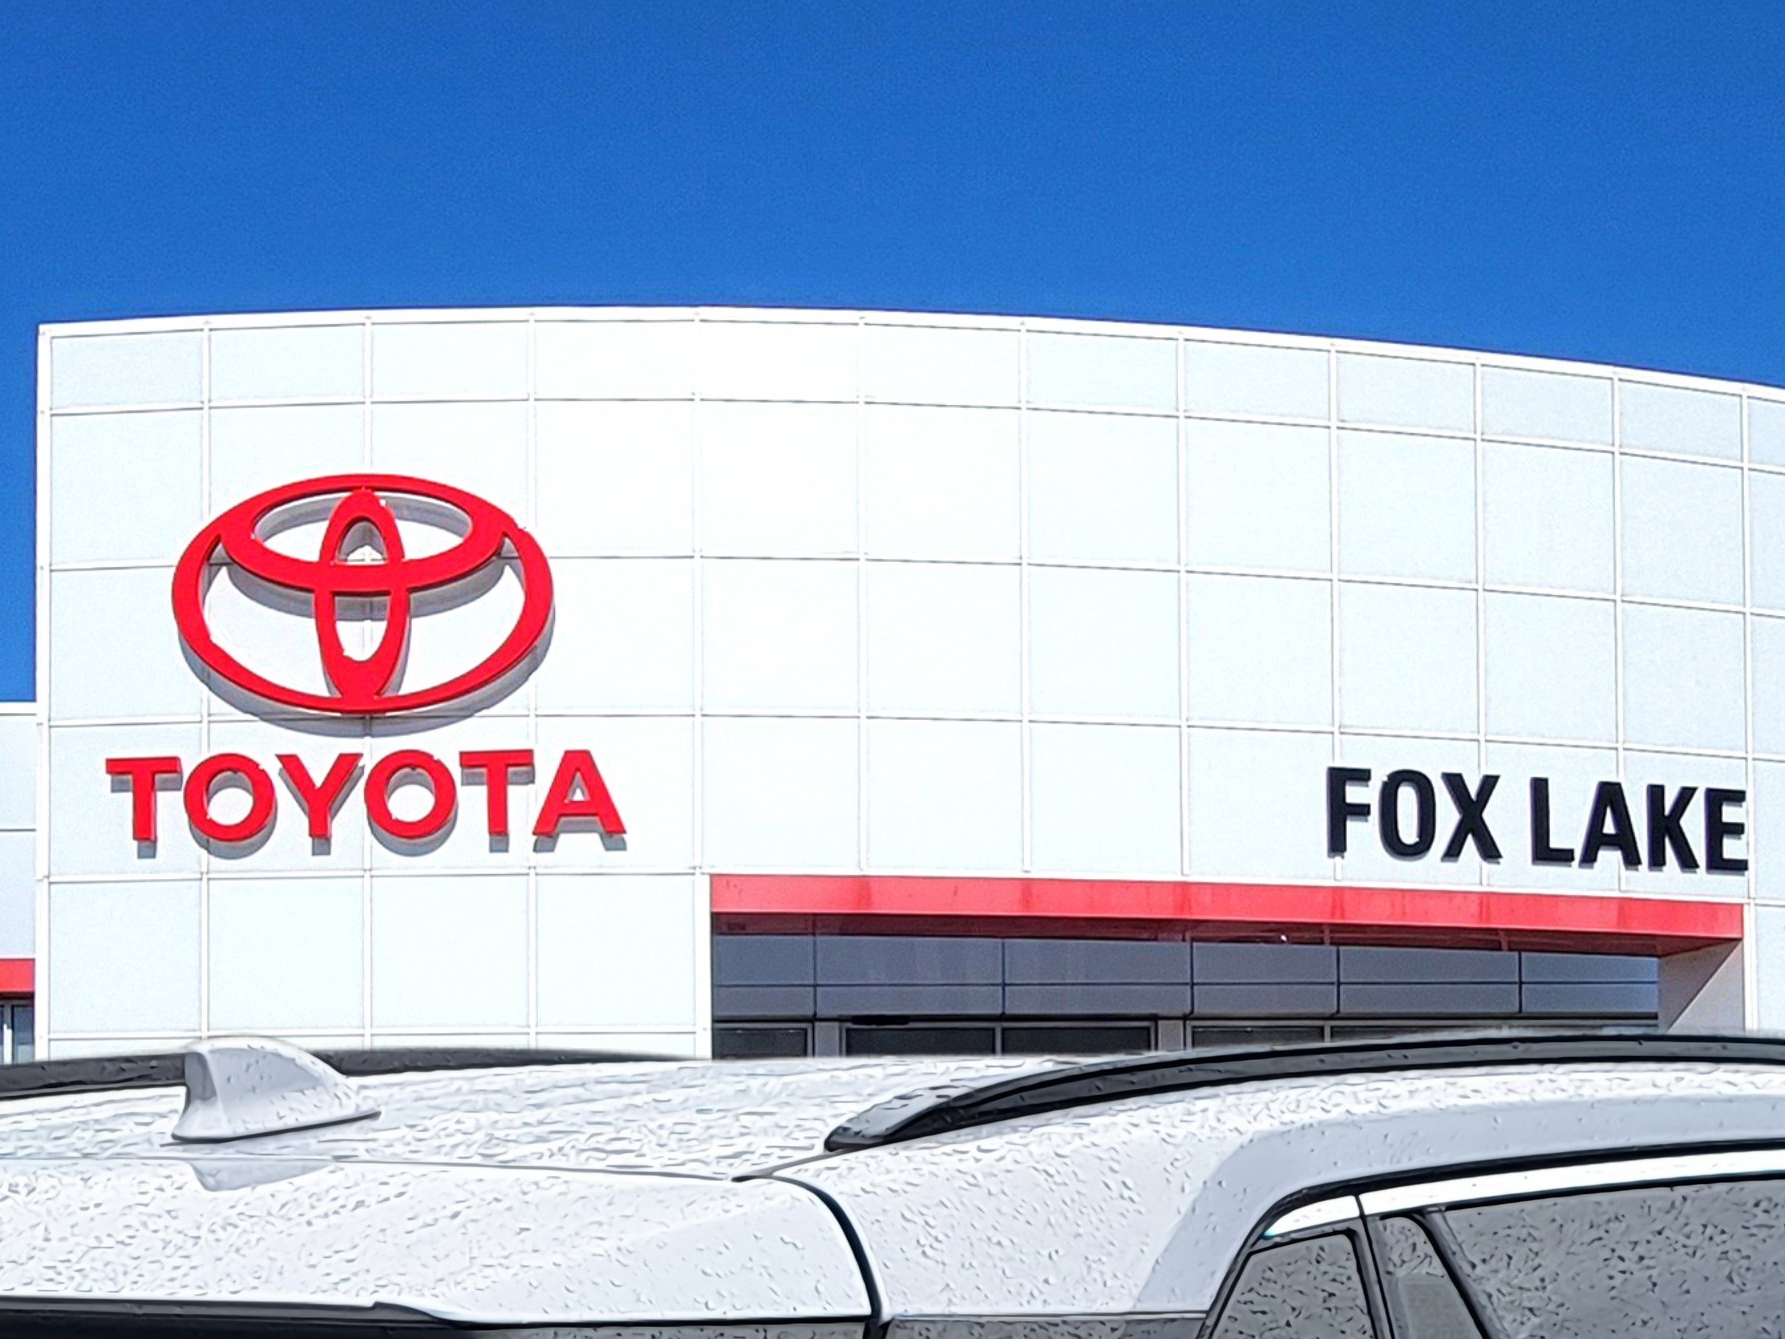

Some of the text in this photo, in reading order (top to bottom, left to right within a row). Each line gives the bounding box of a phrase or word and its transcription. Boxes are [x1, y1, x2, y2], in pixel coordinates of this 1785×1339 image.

[105, 748, 627, 846] TOYOTA
[1326, 766, 1749, 875] FOX LAKE
